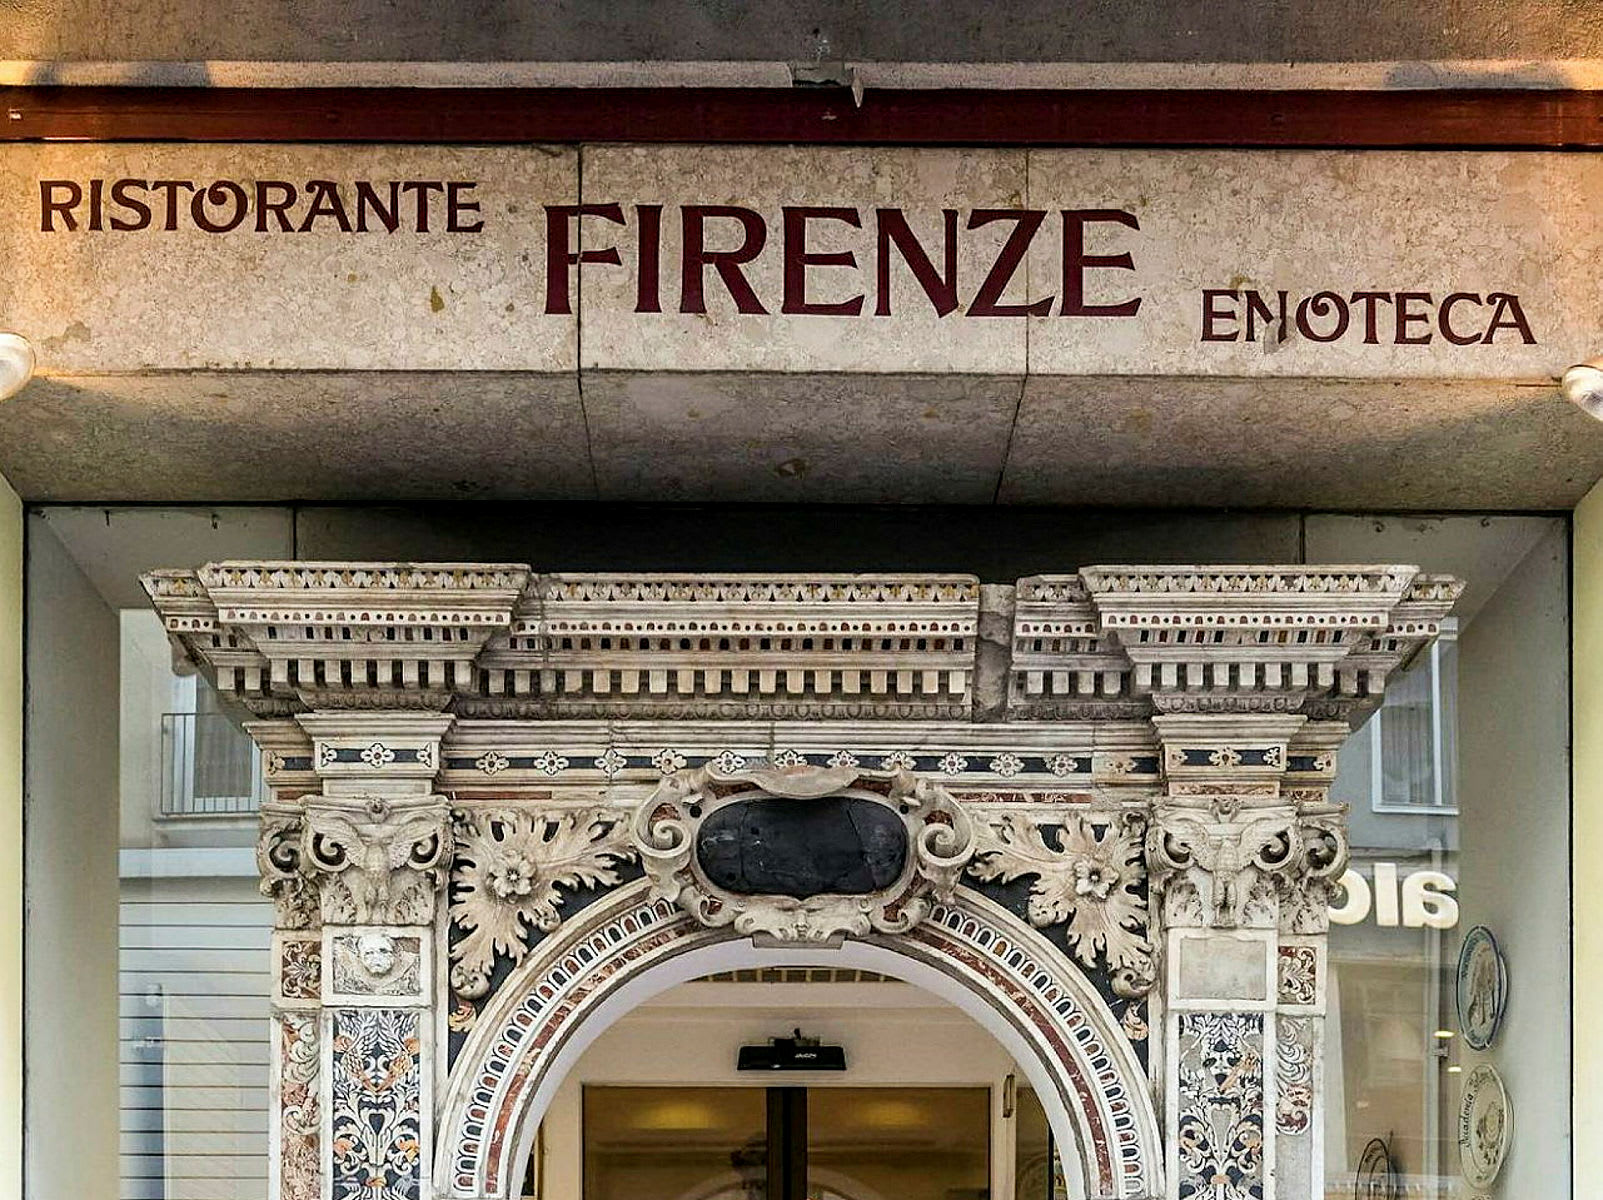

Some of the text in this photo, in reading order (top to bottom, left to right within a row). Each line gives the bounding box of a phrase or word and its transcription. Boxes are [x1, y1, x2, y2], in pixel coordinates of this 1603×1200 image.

[39, 178, 485, 235] RISTORANTE
[543, 203, 1143, 318] FIRENZE
[1200, 288, 1537, 346] ENOTECA
